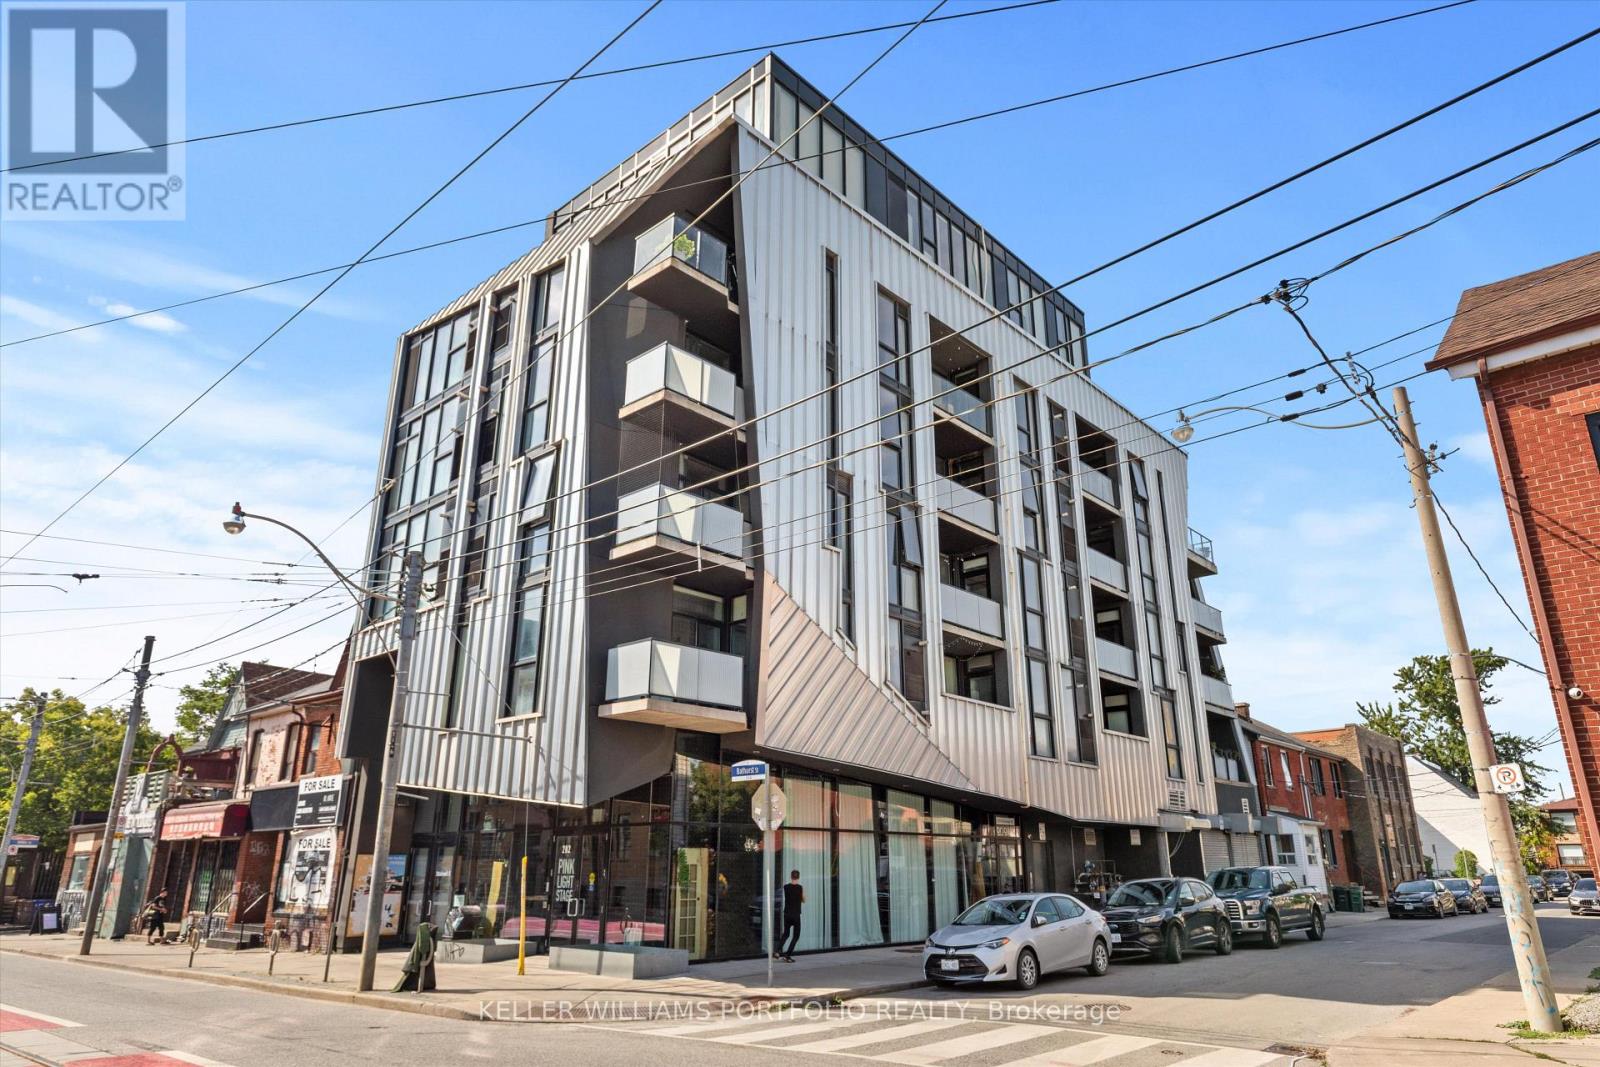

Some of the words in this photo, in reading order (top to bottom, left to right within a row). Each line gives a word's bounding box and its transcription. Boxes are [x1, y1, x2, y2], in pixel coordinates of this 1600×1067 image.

[736, 767, 754, 775] Bathurst
[304, 781, 317, 792] FOR
[319, 778, 335, 790] SALE
[299, 839, 312, 849] FOR
[314, 838, 331, 849] SALE
[558, 858, 575, 875] PINK
[557, 875, 575, 889] LIGHT
[556, 889, 573, 902] STAGE
